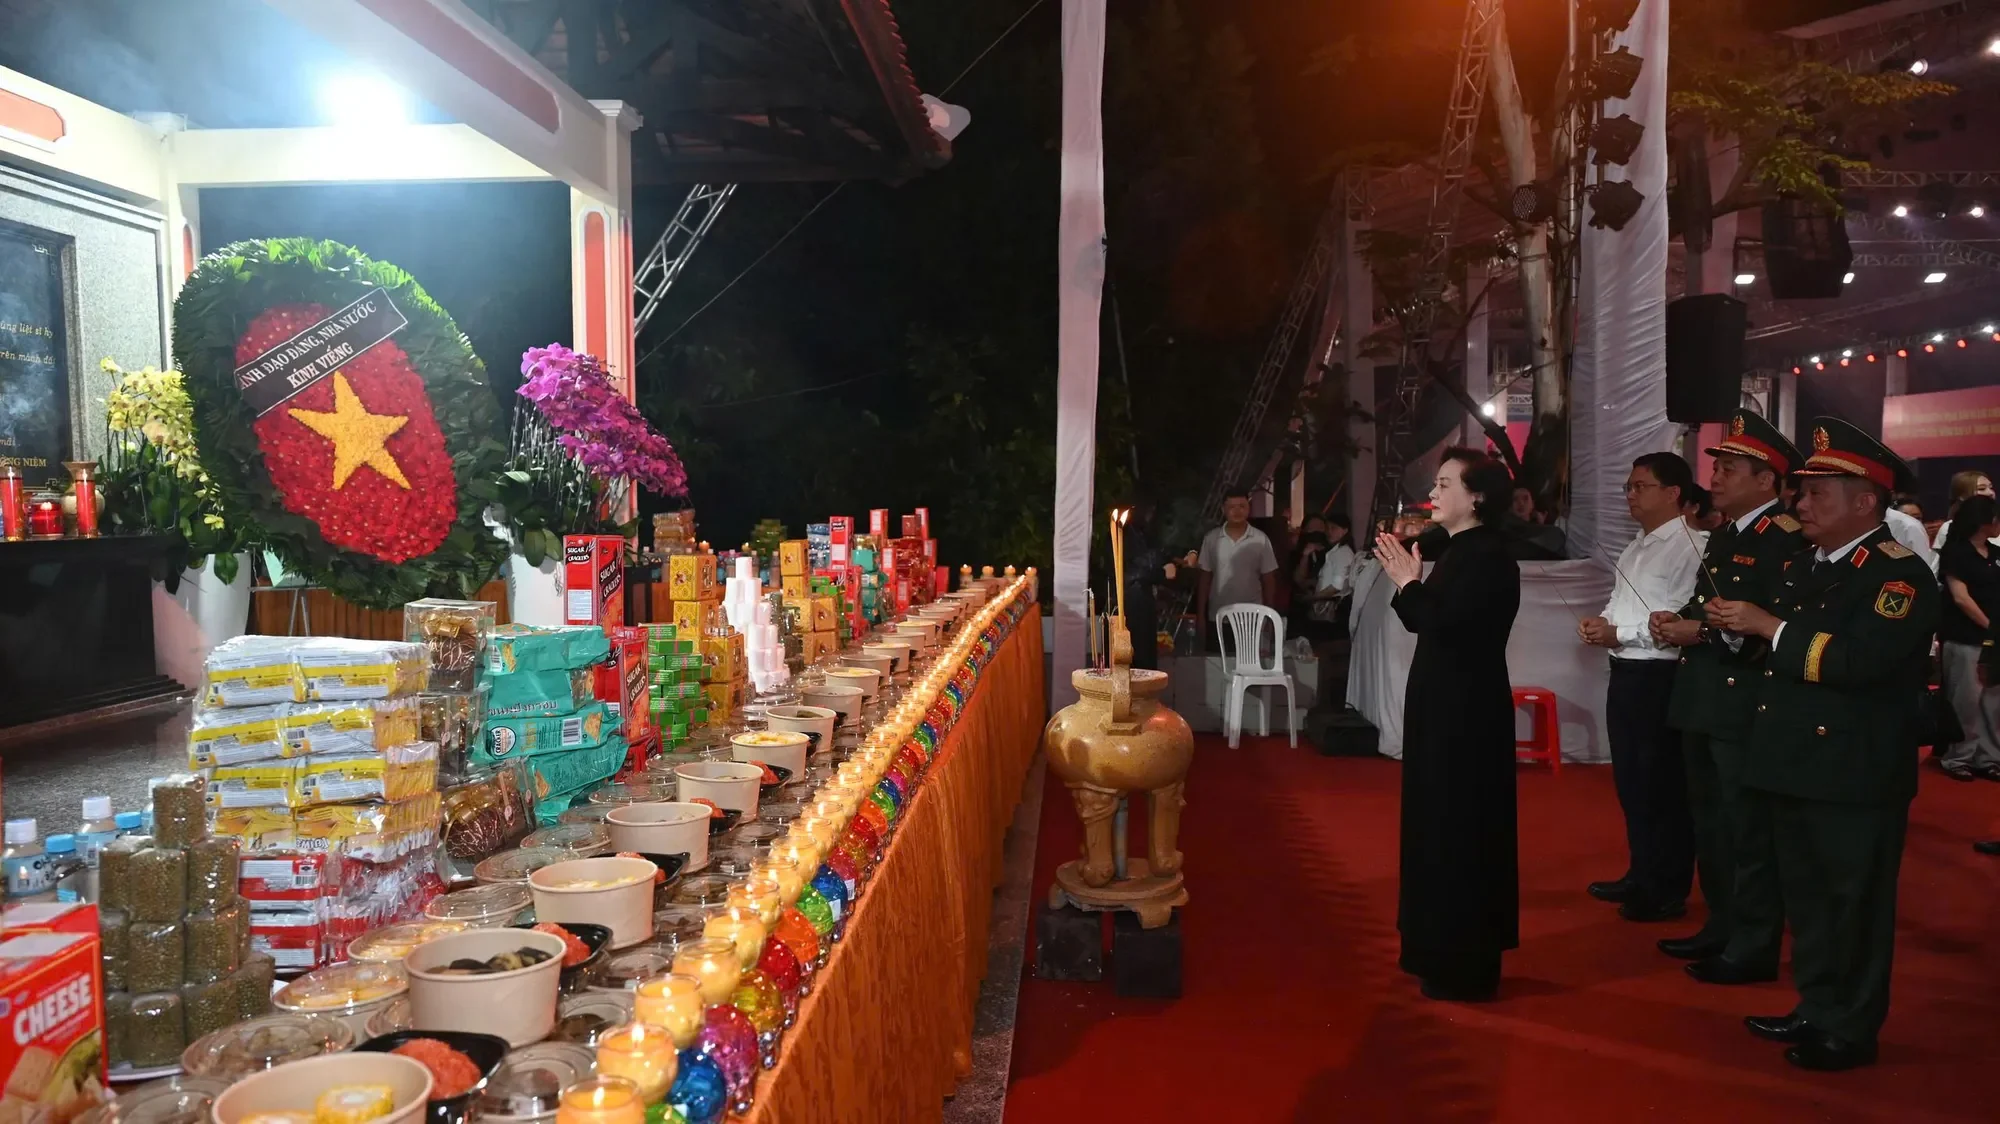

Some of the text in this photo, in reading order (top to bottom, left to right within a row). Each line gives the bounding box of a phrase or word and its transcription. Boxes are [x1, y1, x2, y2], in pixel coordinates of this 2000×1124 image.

[260, 352, 290, 374] ĐẠO
[317, 321, 345, 341] NHÀ
[339, 301, 377, 328] NƯỚC
[286, 342, 354, 389] KÍNH VIẾNG
[23, 456, 47, 469] NIỆM
[567, 546, 585, 554] SUGAR
[600, 560, 616, 582] SUGAR
[626, 662, 641, 686] SUGAR
[13, 972, 92, 1047] CHEESE
